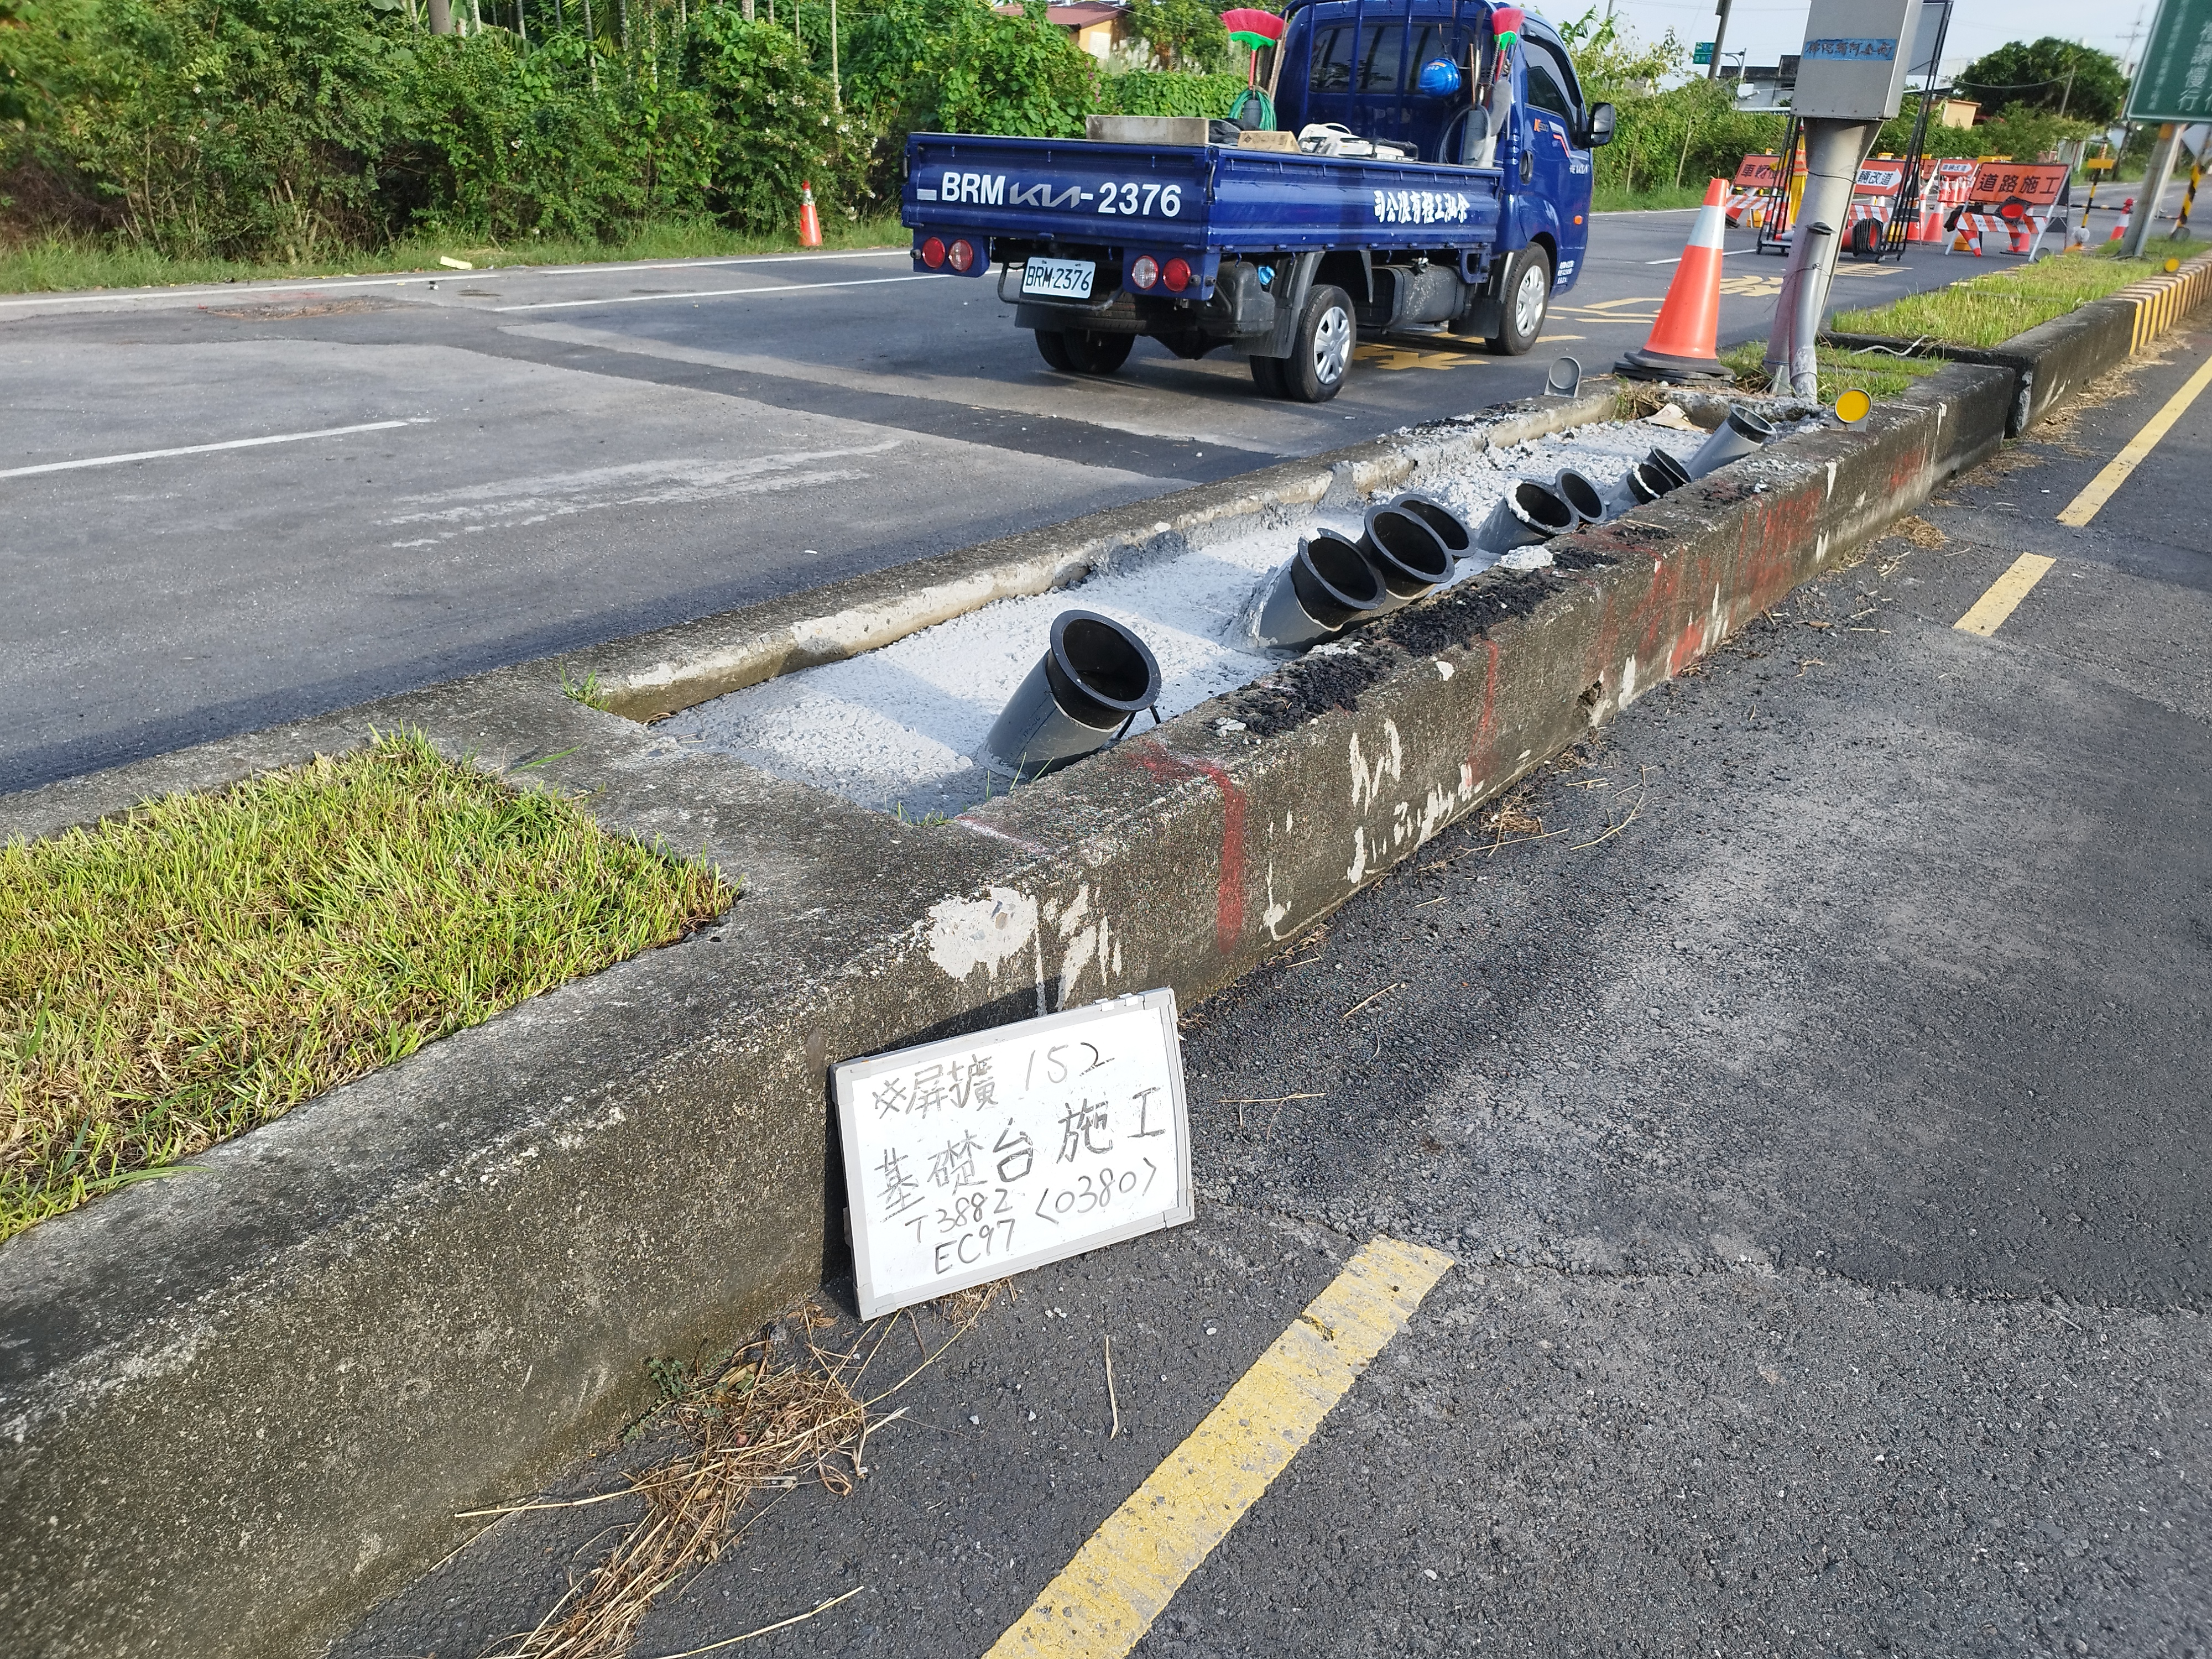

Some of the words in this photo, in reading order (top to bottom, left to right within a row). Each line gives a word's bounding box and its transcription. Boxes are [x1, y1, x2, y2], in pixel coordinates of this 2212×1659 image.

[942, 172, 1006, 205] BRM
[1977, 174, 2060, 194] 道路施工
[1024, 1042, 1115, 1092] 152
[935, 1218, 1015, 1275] EC97
